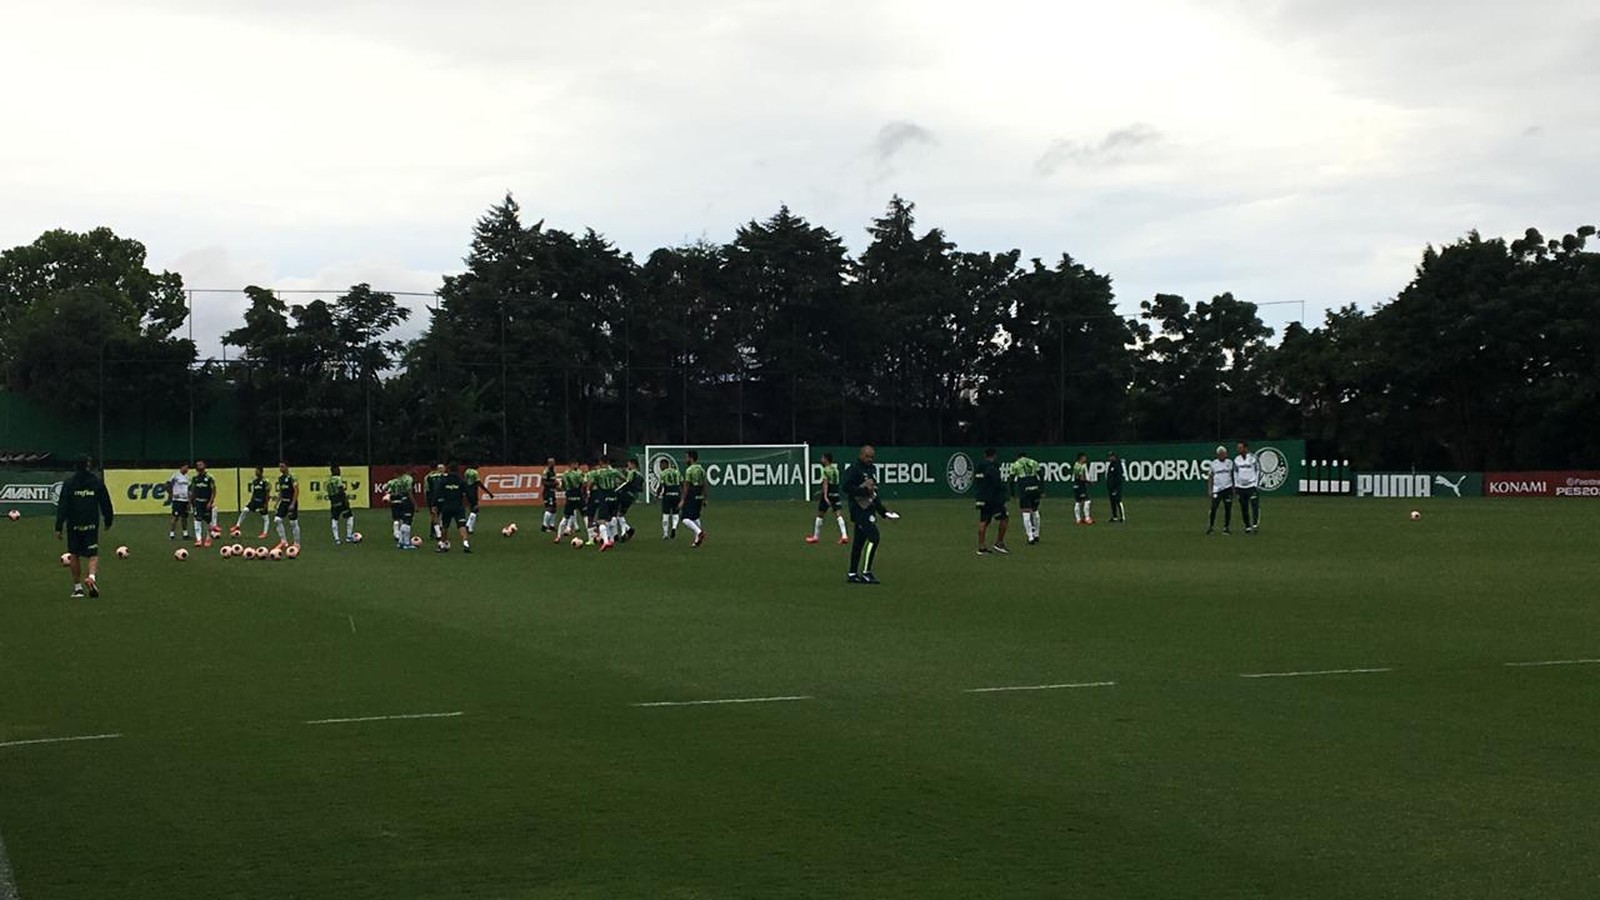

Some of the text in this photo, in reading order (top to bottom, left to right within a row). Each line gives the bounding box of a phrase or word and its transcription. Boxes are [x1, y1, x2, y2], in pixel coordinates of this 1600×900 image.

[706, 463, 804, 486] CADEMIA
[1356, 473, 1432, 497] PUMA
[1489, 481, 1547, 493] KONAMI
[1555, 486, 1600, 496] PES20
[1, 487, 49, 500] AVANTI
